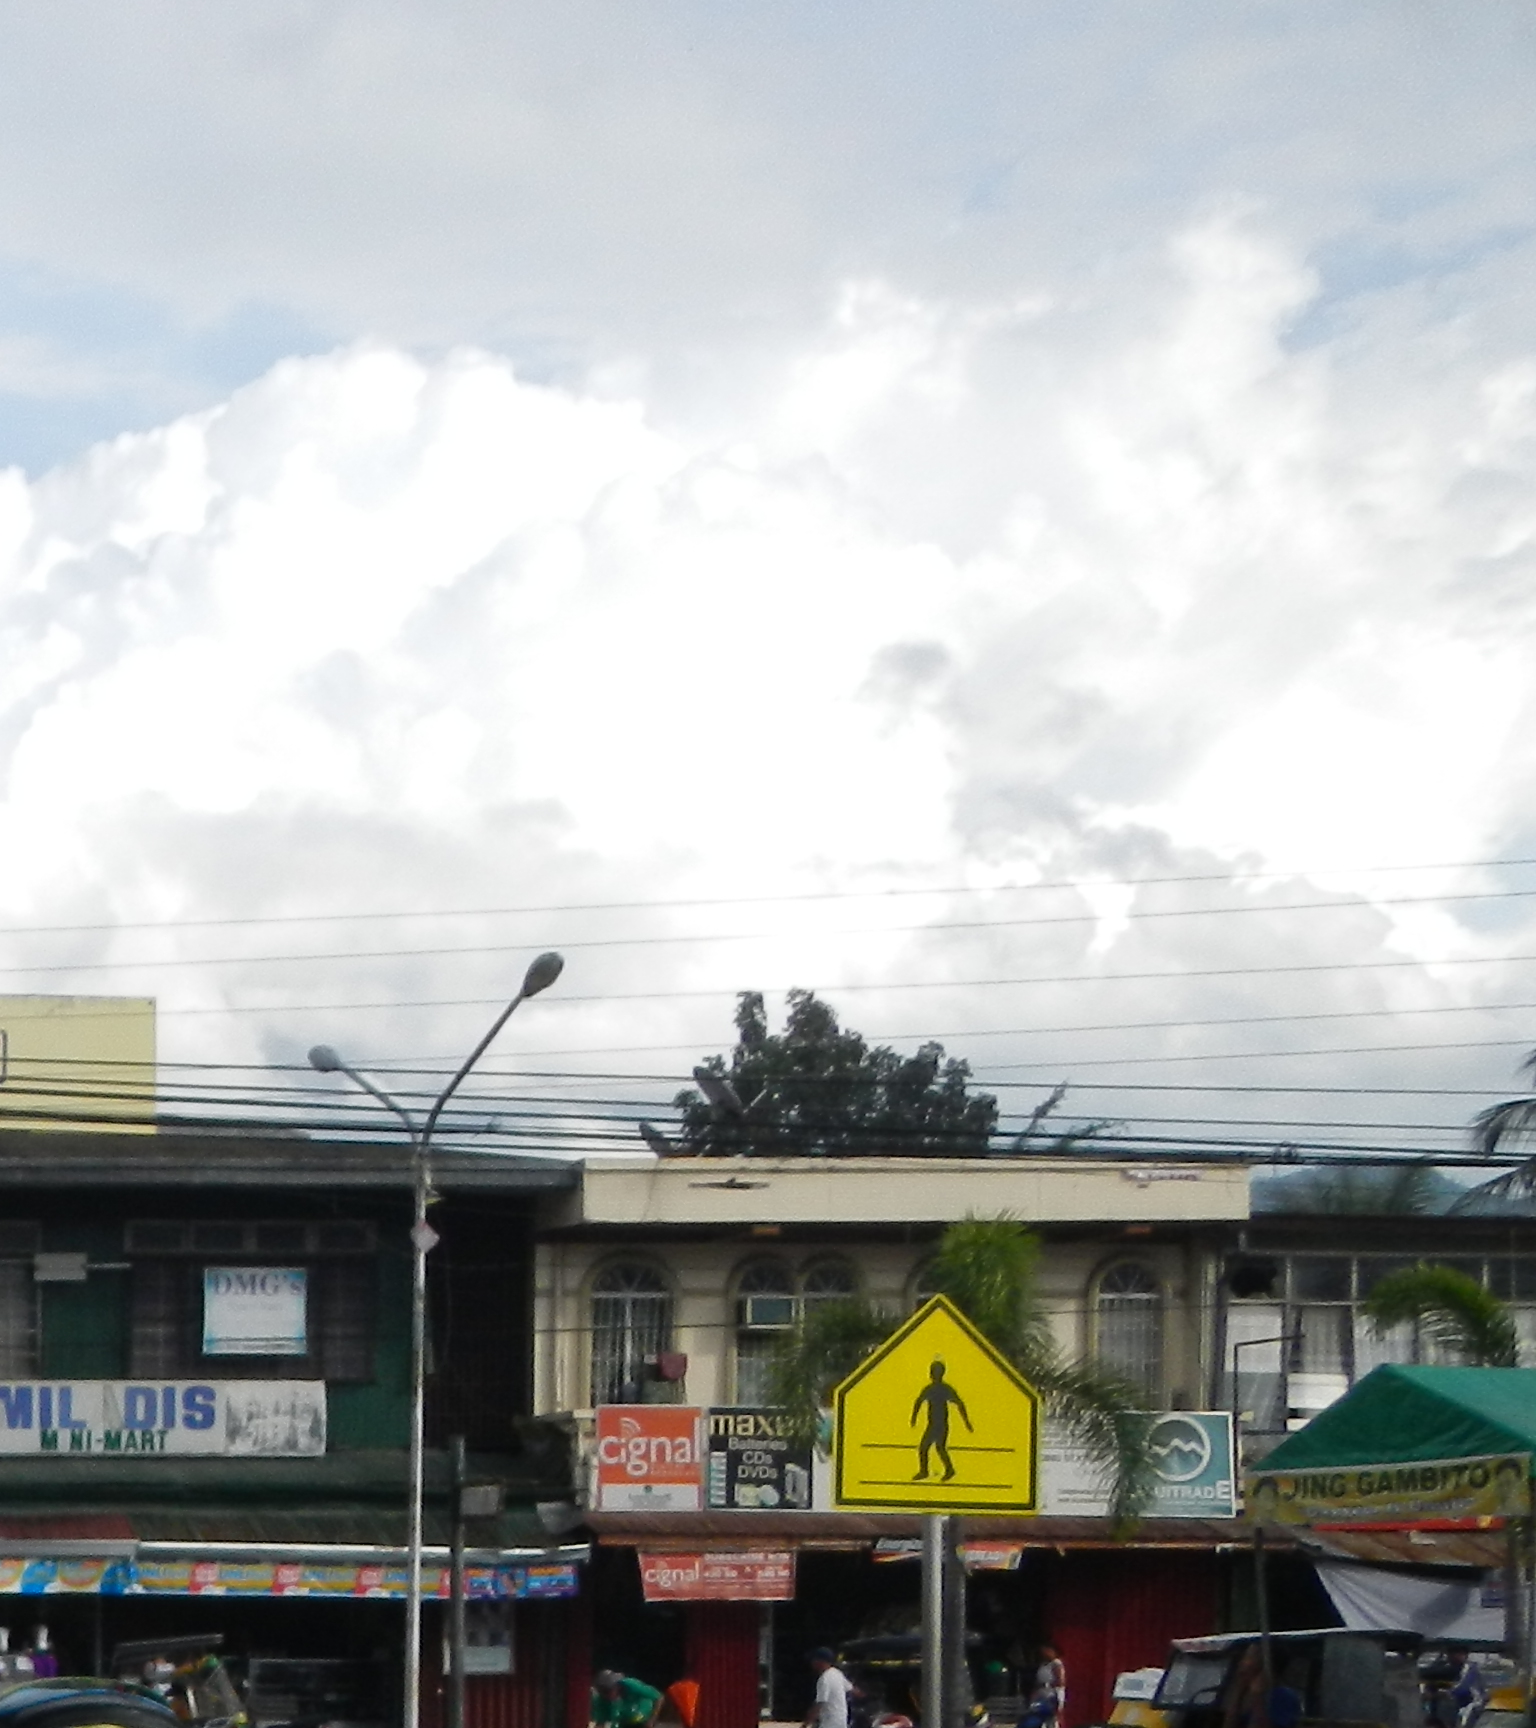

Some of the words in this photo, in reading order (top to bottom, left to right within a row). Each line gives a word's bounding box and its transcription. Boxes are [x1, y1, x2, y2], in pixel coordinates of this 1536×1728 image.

[40, 1429, 169, 1451] MNI-MART
[599, 1417, 702, 1477] cignal
[742, 1451, 774, 1465] CDs
[737, 1465, 778, 1479] DVDs
[1282, 1474, 1347, 1500] JING
[1356, 1464, 1490, 1496] GAMBITO
[645, 1559, 700, 1588] cignal
